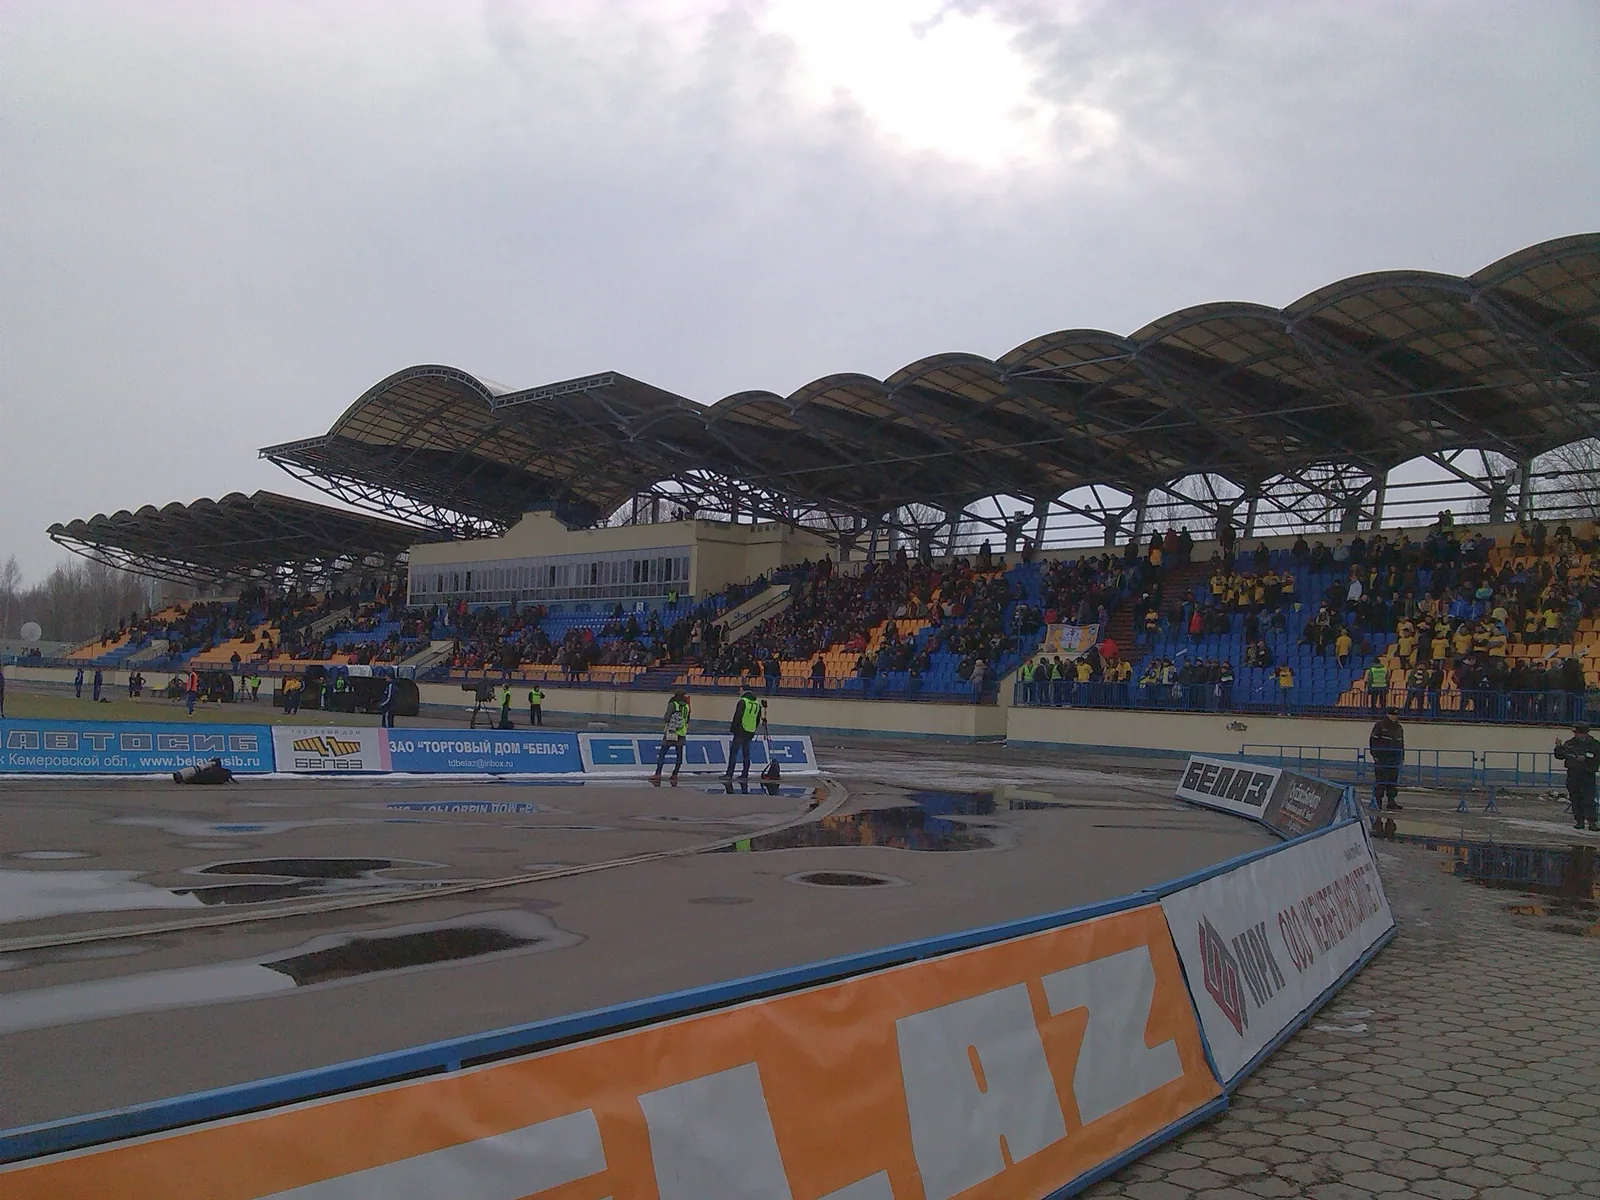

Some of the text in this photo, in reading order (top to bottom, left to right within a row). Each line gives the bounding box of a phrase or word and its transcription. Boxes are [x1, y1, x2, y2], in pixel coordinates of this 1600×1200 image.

[0, 729, 258, 752] АВТОСИБ
[389, 740, 415, 753] ЗАО
[494, 742, 521, 756] ДОМ
[9, 753, 100, 768] Кемеровской
[103, 754, 136, 768] обл.,
[447, 758, 514, 769] tdbelaz@inbox.ru
[1182, 761, 1275, 807] БЕЛАЗ
[1278, 905, 1314, 974] ООО
